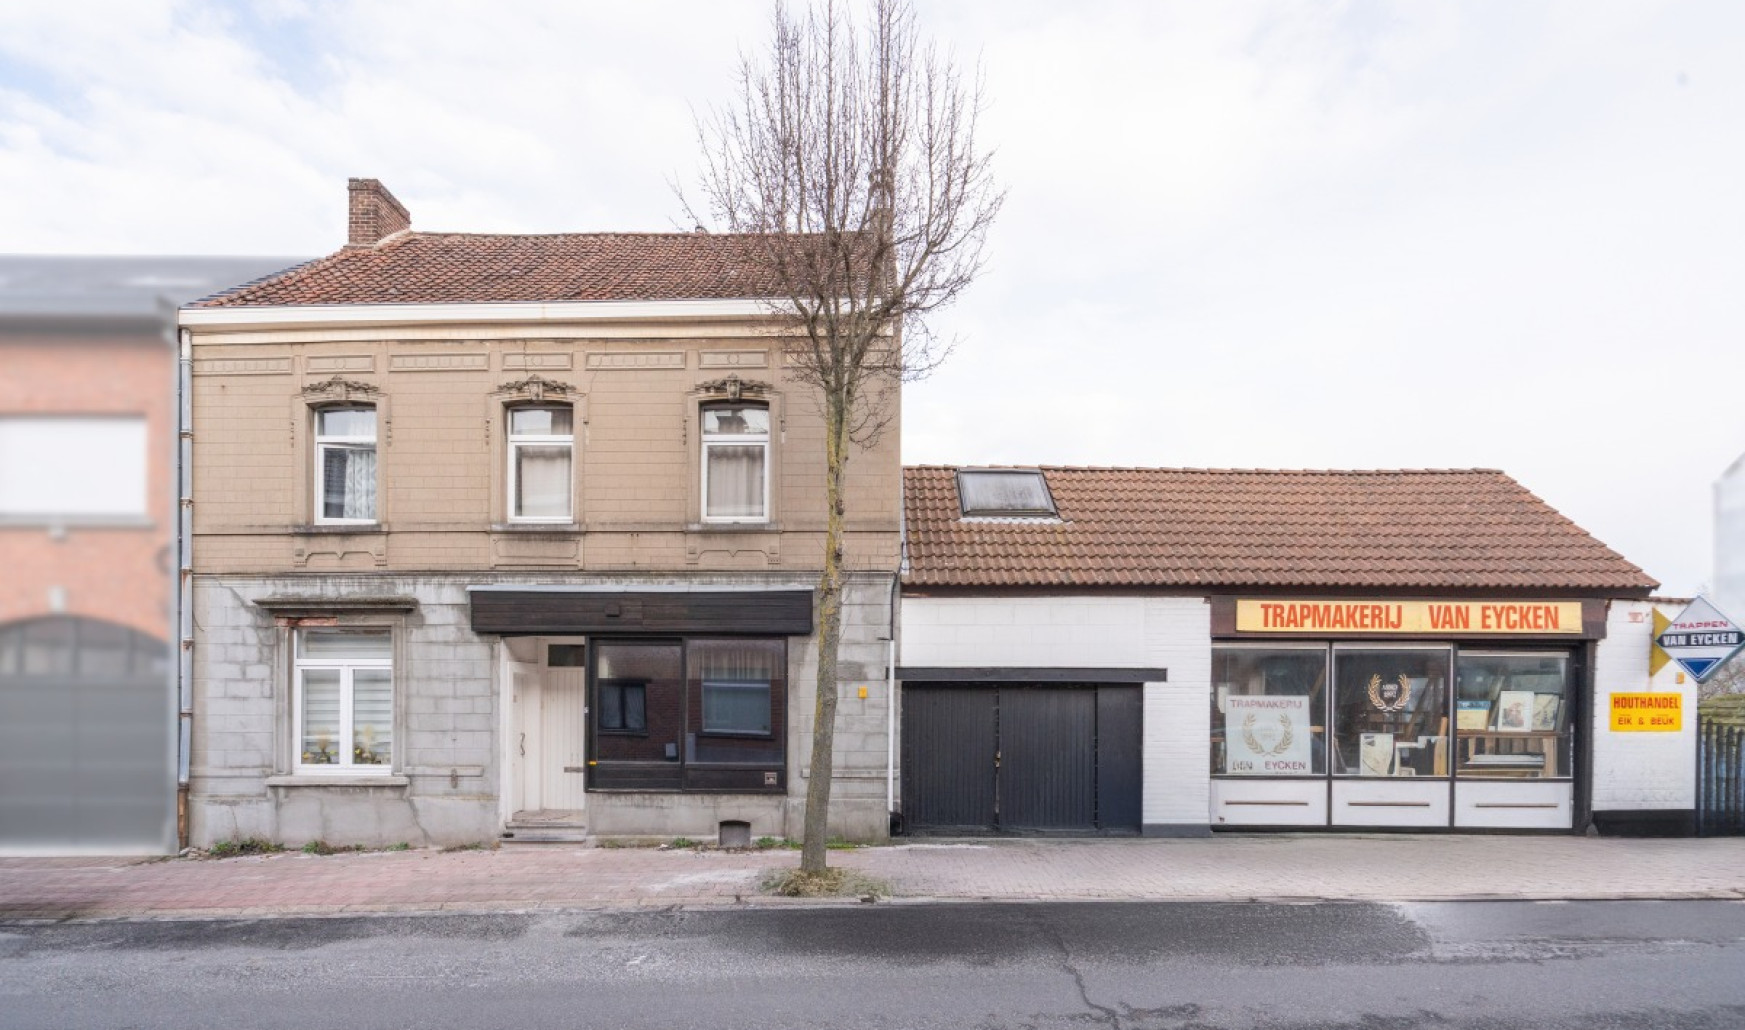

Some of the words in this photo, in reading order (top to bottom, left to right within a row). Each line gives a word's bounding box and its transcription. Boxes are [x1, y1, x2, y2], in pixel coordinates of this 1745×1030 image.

[1260, 604, 1403, 629] TRAPMAKERIJ
[1428, 604, 1470, 629] VAN
[1481, 605, 1560, 630] EYCKEN
[1672, 620, 1728, 630] TRAPPEN
[1663, 635, 1686, 646] VAN
[1690, 633, 1738, 646] EYCKEN
[1230, 699, 1302, 709] TRAPMAKERIJ
[1613, 697, 1679, 709] HOUTHANDEL
[1617, 717, 1633, 726] EIK
[1650, 717, 1675, 726] BEUK
[1264, 760, 1307, 771] EYCKEN
